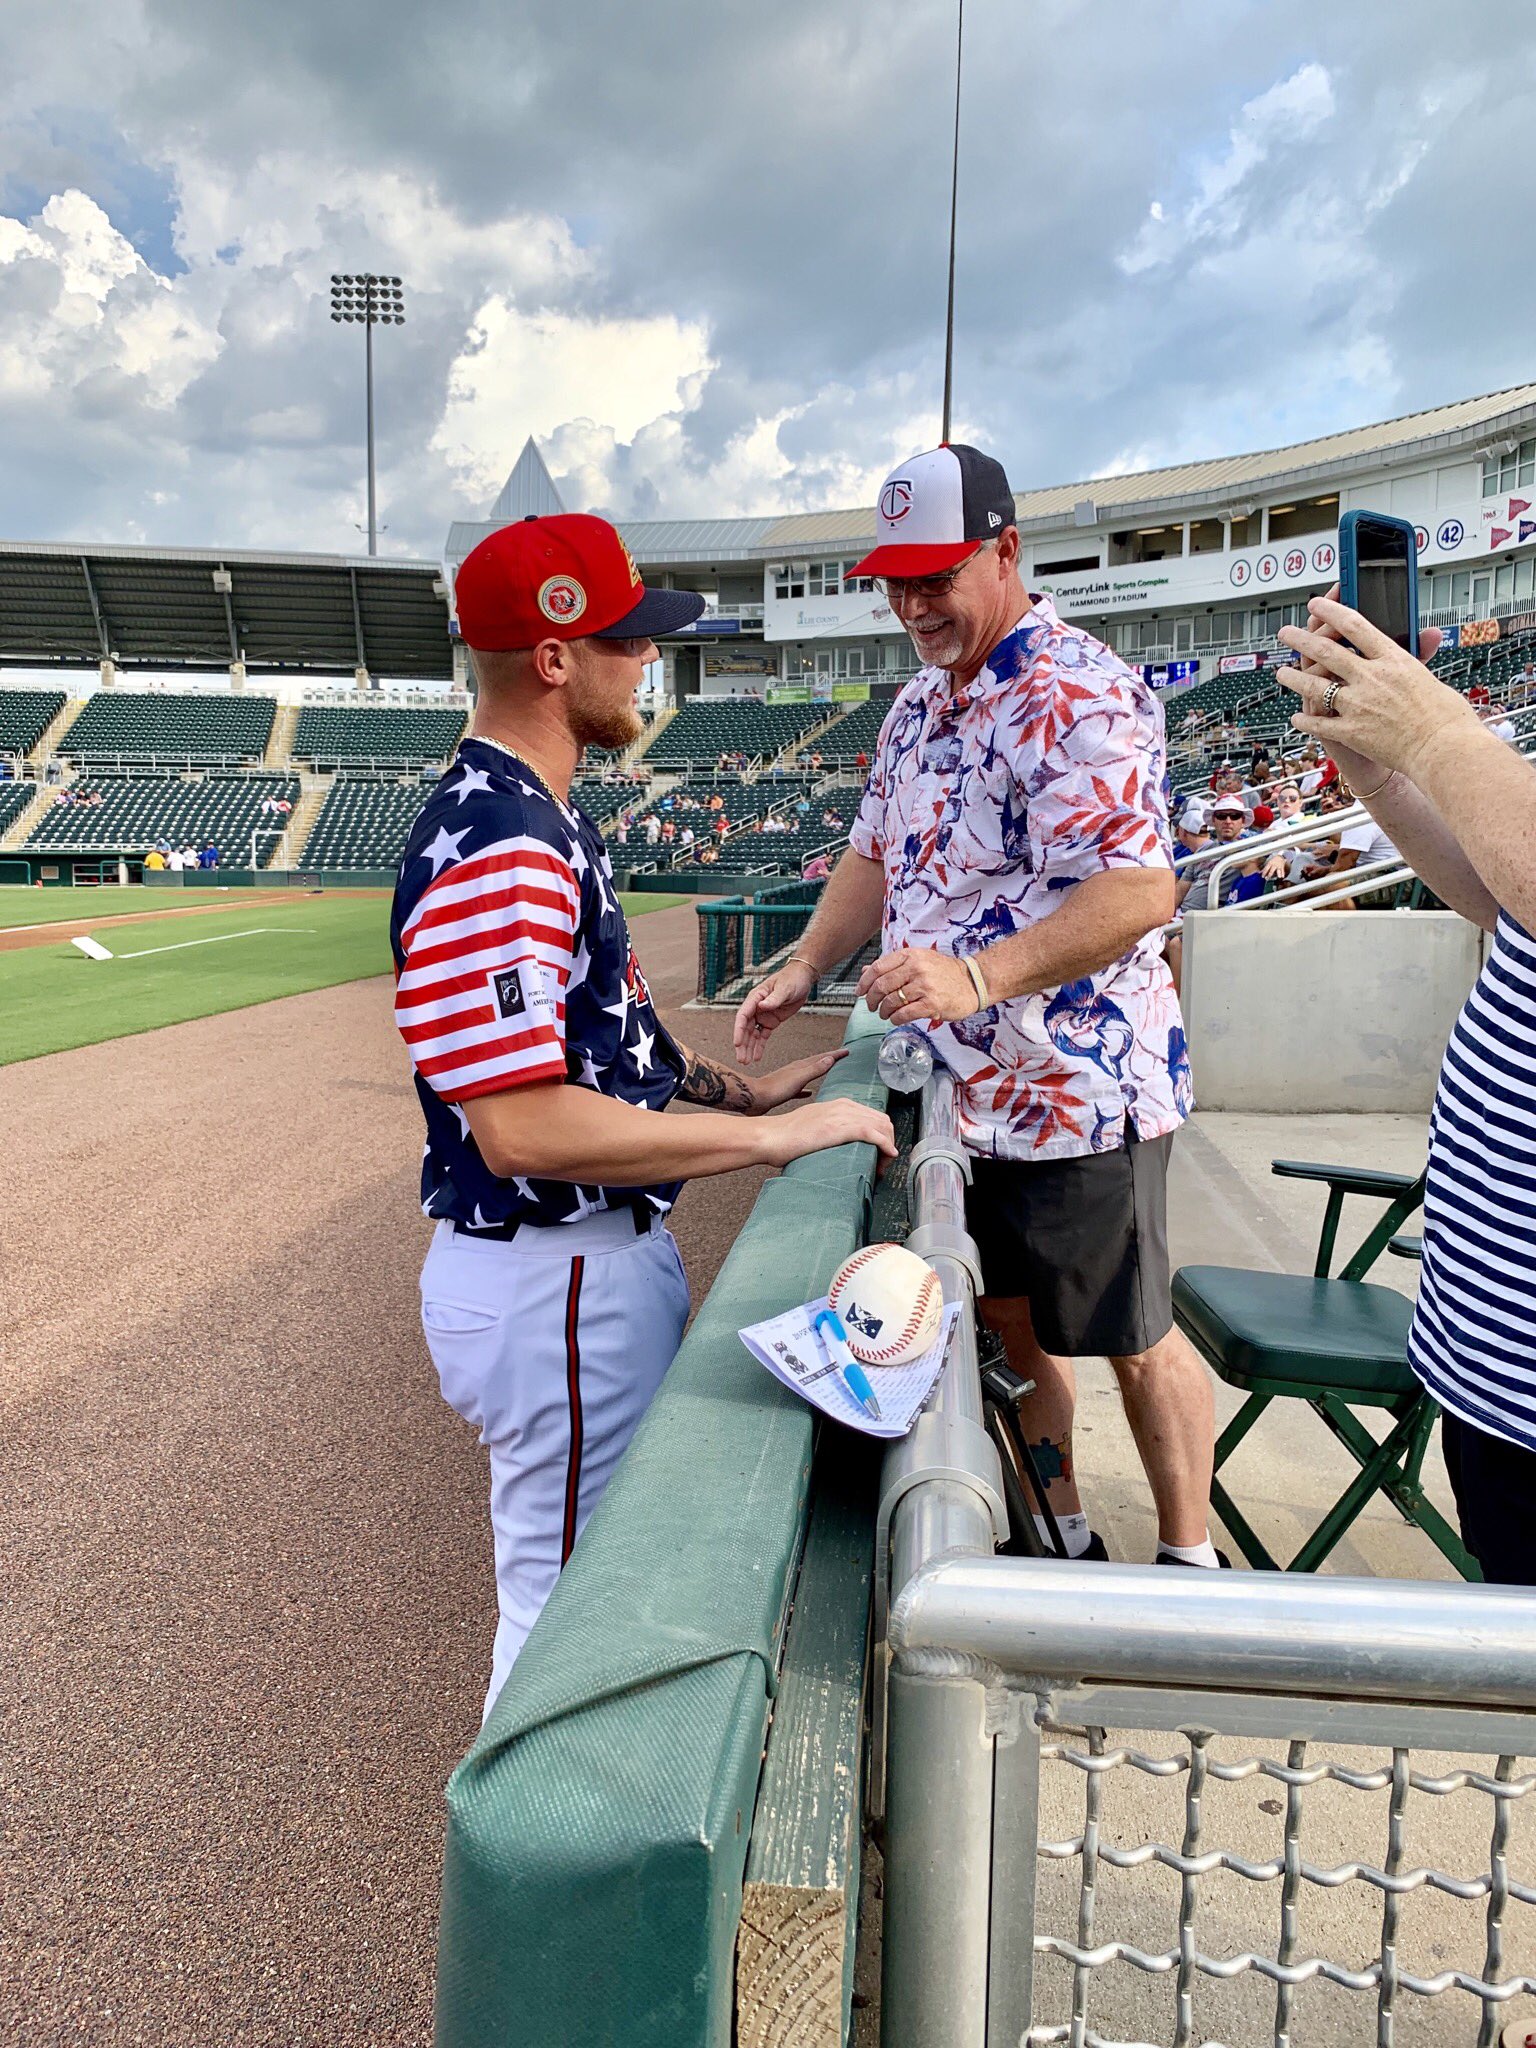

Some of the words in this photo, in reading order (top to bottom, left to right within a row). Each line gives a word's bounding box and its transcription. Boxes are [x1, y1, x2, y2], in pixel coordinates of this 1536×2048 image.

[1441, 526, 1459, 543] 42
[1287, 555, 1303, 572] 29
[1317, 549, 1332, 566] 14
[1237, 566, 1244, 581] 3
[1263, 560, 1271, 575] 6
[1056, 582, 1110, 598] CenturyLink
[1113, 582, 1136, 591] Sports
[1137, 578, 1169, 588] Complex
[1069, 598, 1110, 608] HAMMOND
[1112, 592, 1148, 603] STADIUM
